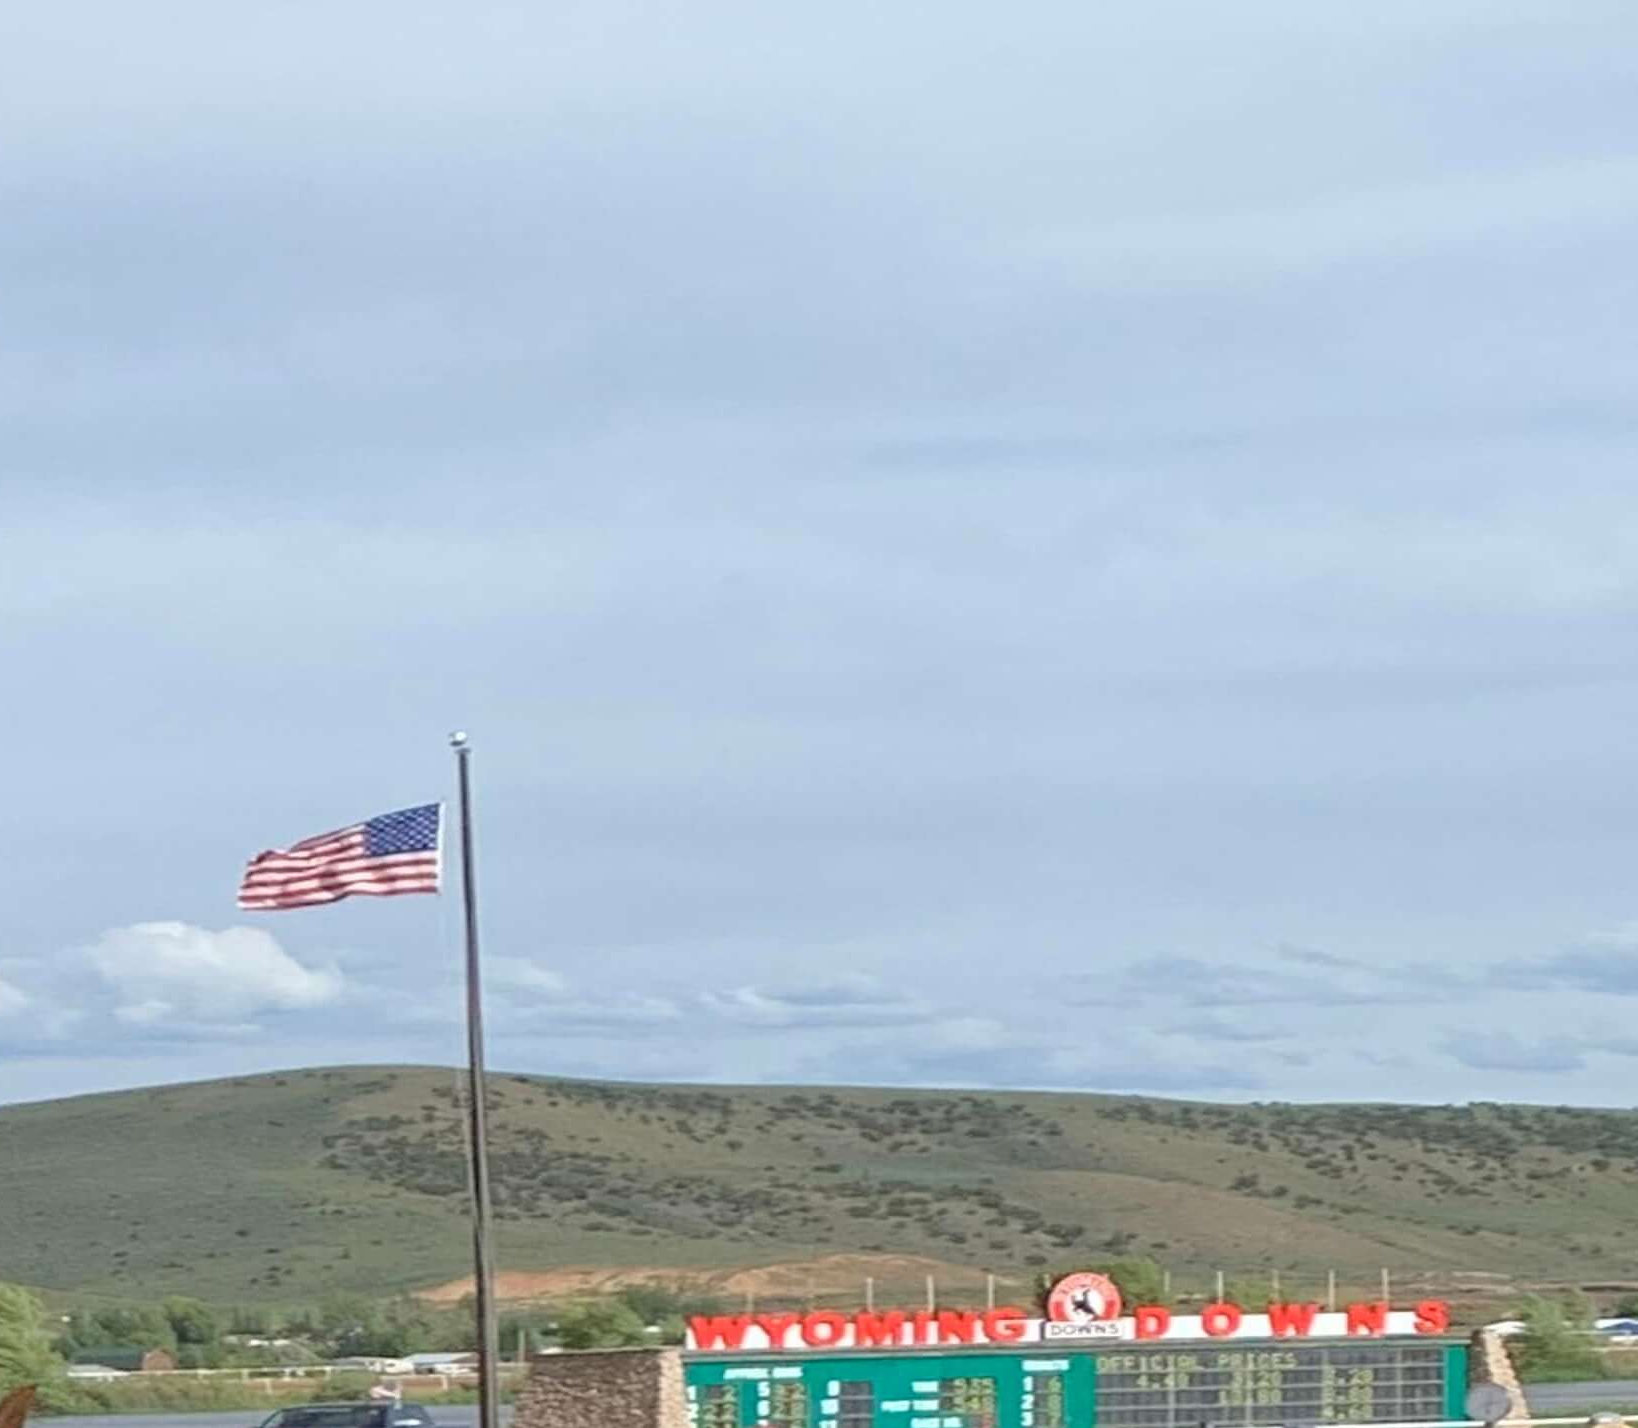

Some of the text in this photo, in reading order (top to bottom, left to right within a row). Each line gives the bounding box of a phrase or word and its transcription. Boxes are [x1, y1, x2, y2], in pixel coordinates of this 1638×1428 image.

[689, 1300, 1450, 1349] WYOMING DOWNS
[1050, 1323, 1119, 1336] DOWNS
[1096, 1353, 1298, 1371] OFFICIAL PRICES
